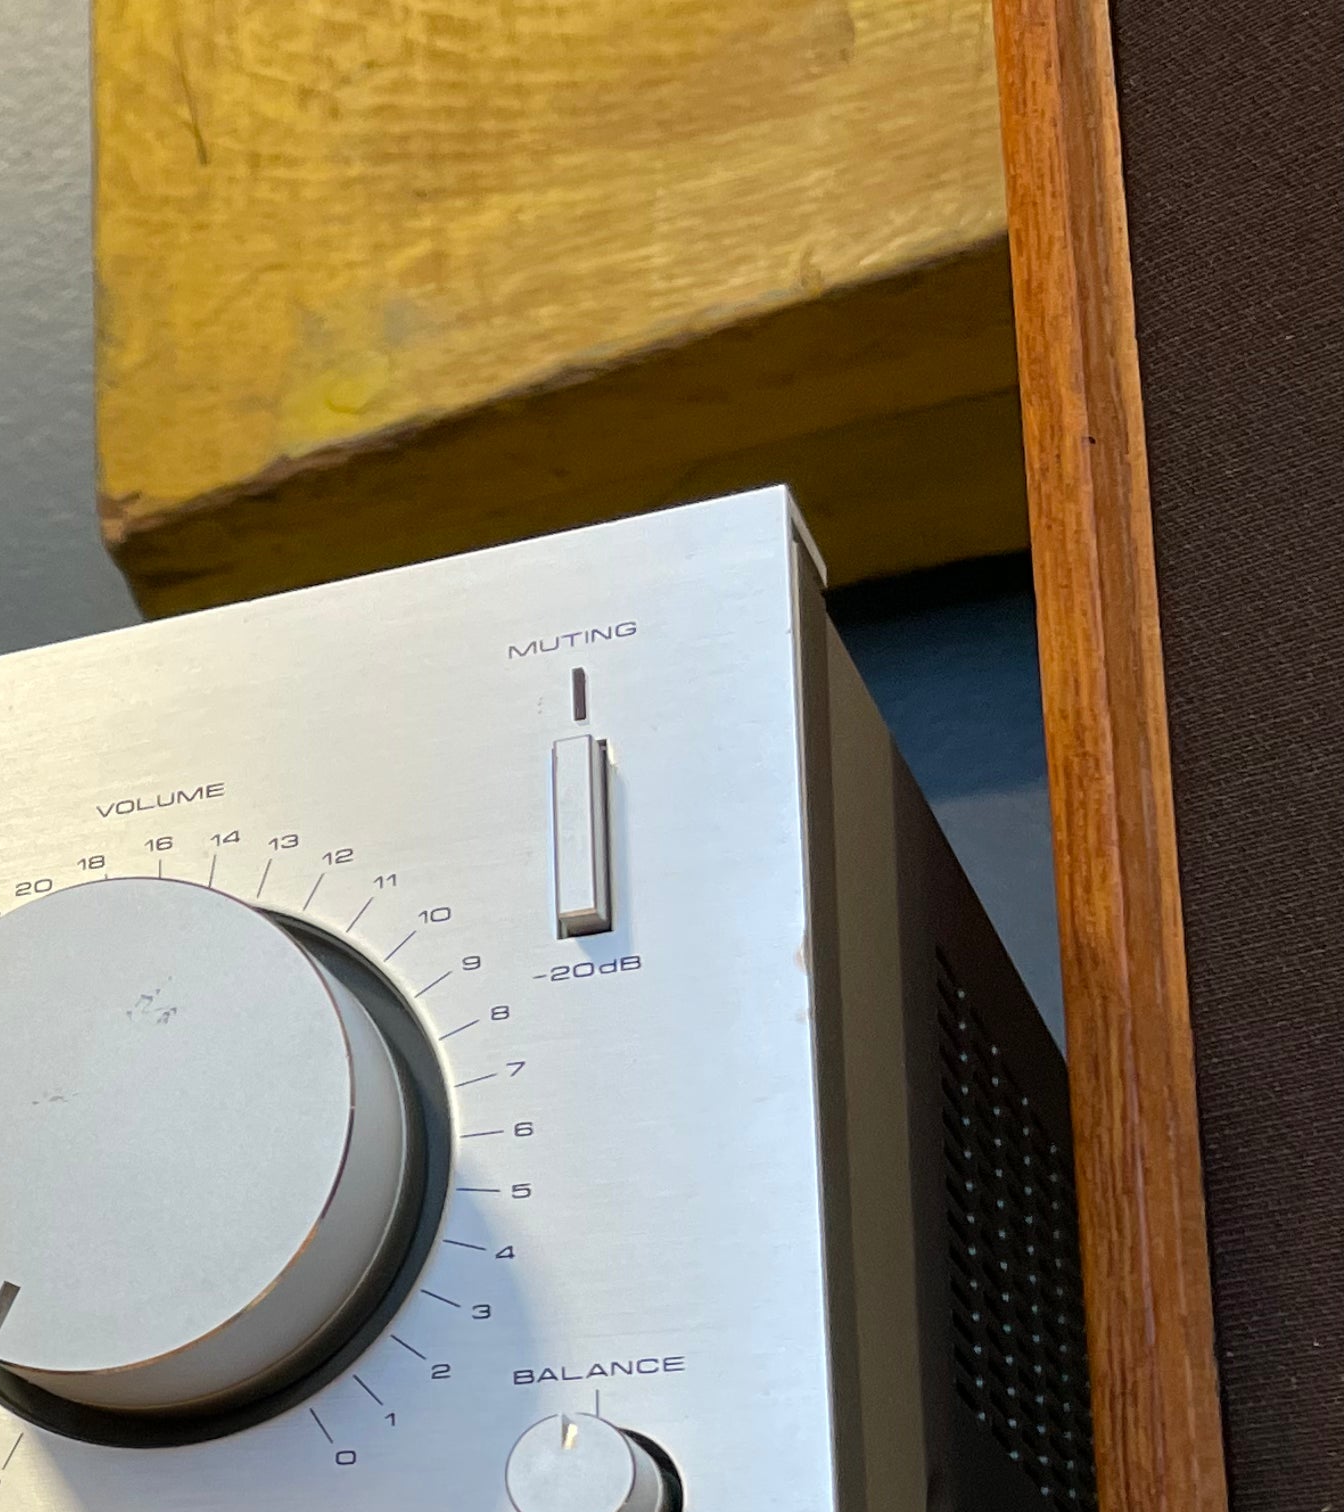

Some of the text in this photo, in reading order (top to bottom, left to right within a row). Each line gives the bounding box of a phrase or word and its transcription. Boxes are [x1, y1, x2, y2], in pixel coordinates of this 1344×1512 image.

[508, 621, 637, 659] MUTING
[96, 782, 226, 819] VOLUME
[145, 836, 174, 853] 16
[211, 830, 241, 848] 14
[268, 833, 300, 851] 13
[77, 855, 106, 871] 18
[322, 848, 355, 865] 12
[15, 879, 53, 897] 20
[373, 873, 398, 889] 11
[419, 907, 452, 924] 10
[462, 956, 481, 971] 9
[491, 1006, 510, 1021] 8
[507, 1062, 525, 1077] 7
[514, 1122, 533, 1138] 6
[512, 1184, 531, 1199] 5
[495, 1246, 515, 1260] 4
[471, 1304, 491, 1320] 3
[431, 1363, 451, 1380] 2
[513, 1356, 686, 1385] BALANCE
[385, 1412, 396, 1427] 1
[336, 1451, 357, 1466] 0
